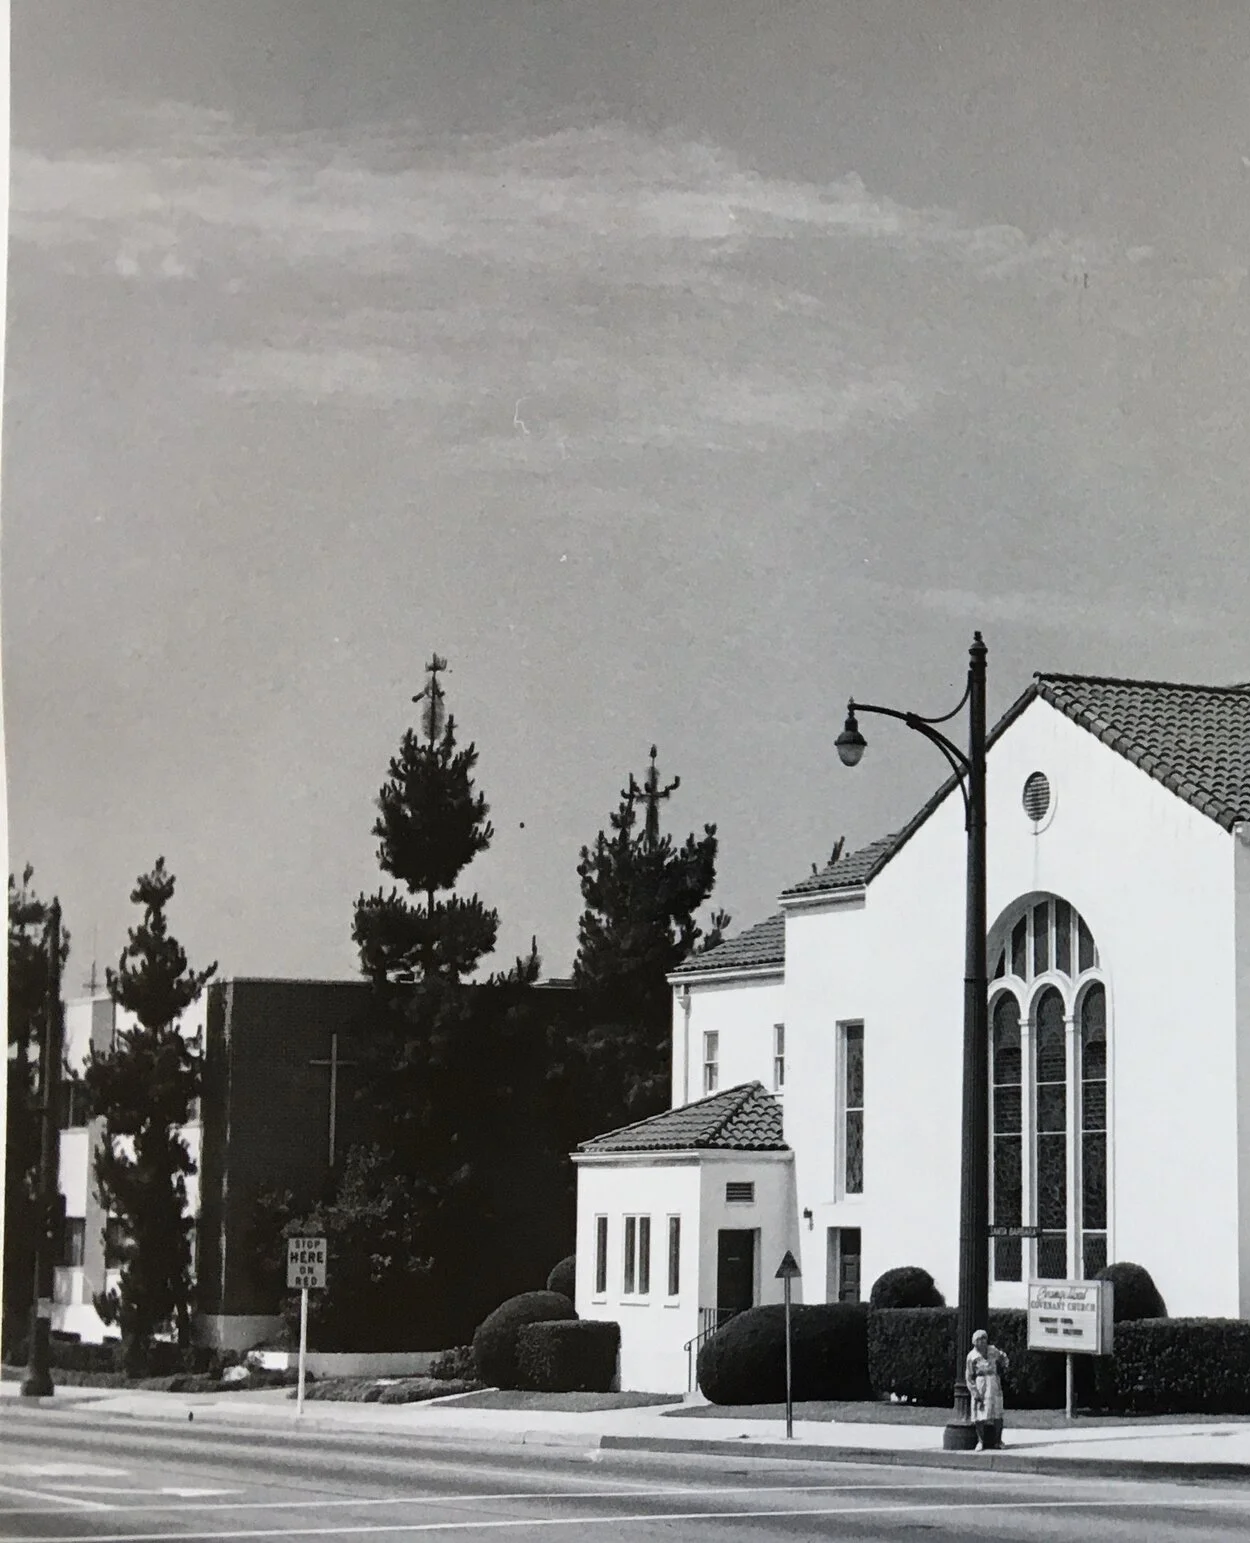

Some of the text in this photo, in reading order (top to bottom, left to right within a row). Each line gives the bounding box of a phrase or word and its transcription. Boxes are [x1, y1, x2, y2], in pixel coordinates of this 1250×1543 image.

[295, 1239, 321, 1249] STOP
[290, 1250, 324, 1264] HERE
[300, 1266, 314, 1275] ON
[295, 1276, 318, 1287] RED
[1031, 1300, 1096, 1312] COVENANT CHURCH
